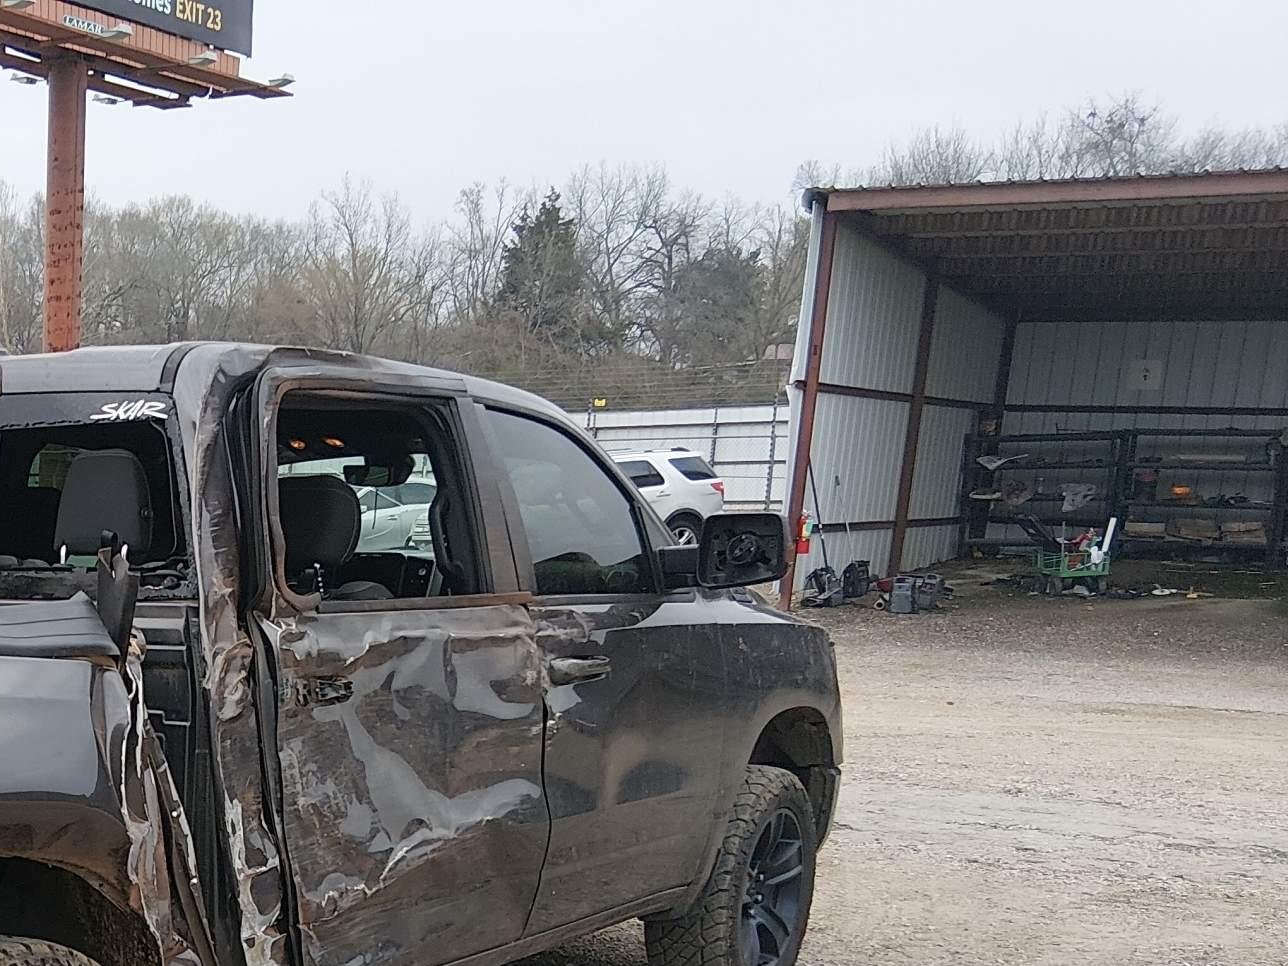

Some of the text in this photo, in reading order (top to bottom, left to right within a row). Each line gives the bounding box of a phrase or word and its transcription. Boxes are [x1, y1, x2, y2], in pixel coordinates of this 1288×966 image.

[175, 0, 205, 25] EXIT
[206, 7, 222, 31] 23
[90, 399, 168, 420] SKAR
